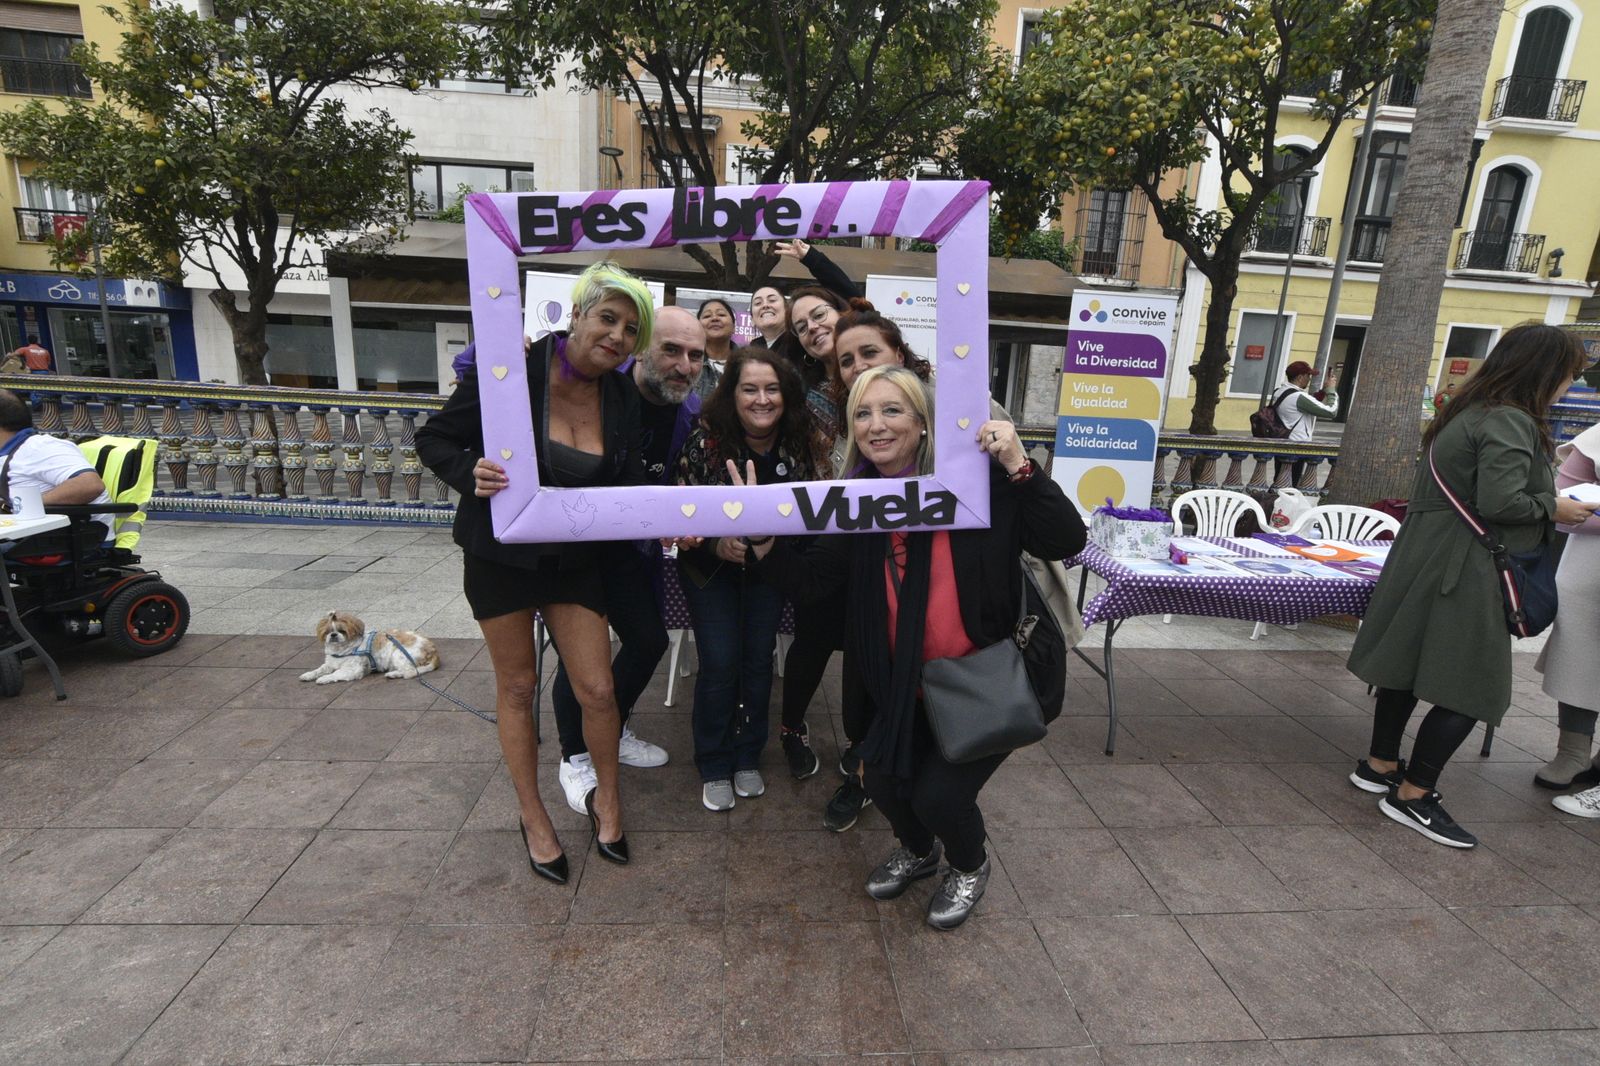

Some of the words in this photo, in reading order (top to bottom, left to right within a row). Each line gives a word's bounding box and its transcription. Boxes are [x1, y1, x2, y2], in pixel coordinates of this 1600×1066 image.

[518, 196, 648, 247] Eres
[1112, 307, 1167, 320] convive
[1078, 340, 1104, 352] Vive
[1076, 354, 1088, 366] la
[1090, 355, 1157, 370] Diversidad
[1073, 382, 1099, 393] Vive
[1102, 384, 1114, 394] la
[1071, 396, 1128, 409] Igualdad
[1068, 422, 1093, 435] Vive
[1096, 424, 1108, 435] la
[1065, 436, 1138, 450] Solidaridad
[791, 480, 958, 531] Vuela
